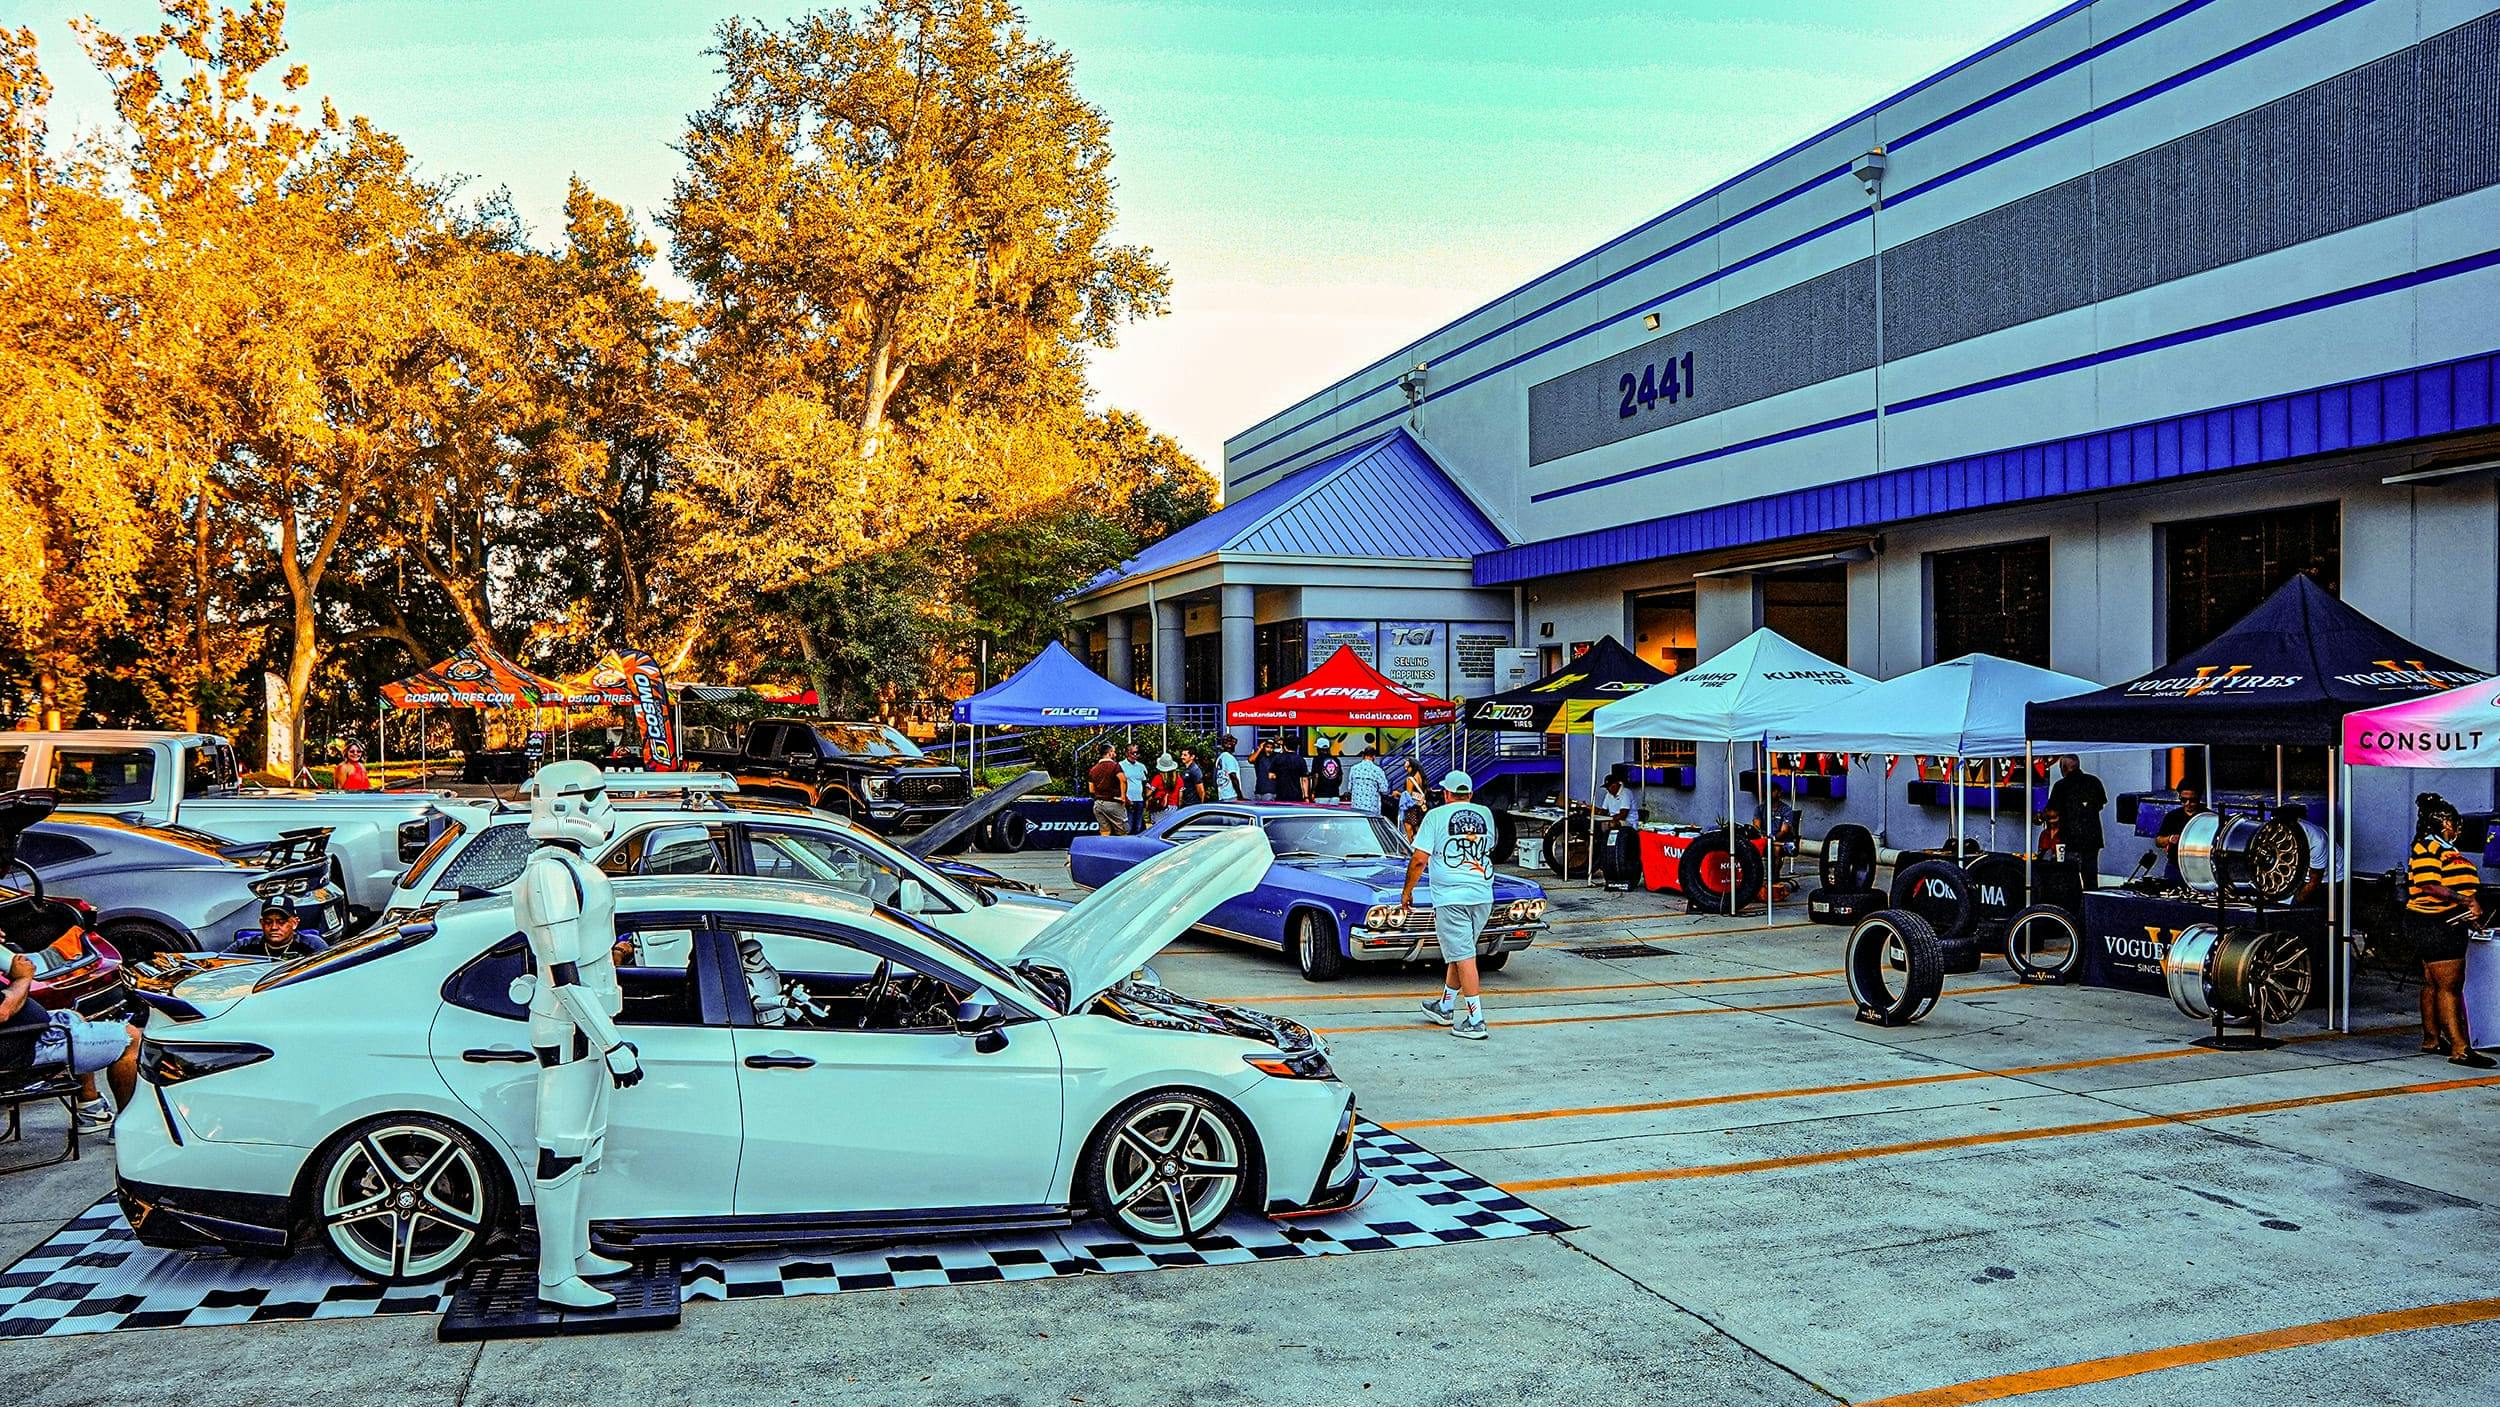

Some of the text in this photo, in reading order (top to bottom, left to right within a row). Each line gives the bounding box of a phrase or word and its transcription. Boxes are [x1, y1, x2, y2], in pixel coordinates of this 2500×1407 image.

[1619, 351, 1694, 418] 2441
[1391, 628, 1434, 646] TGI
[1394, 657, 1428, 667] SELLING
[1389, 670, 1435, 680] HAPPINESS
[1680, 672, 1738, 683] KUMHO
[1763, 671, 1847, 680] KUMHO
[404, 693, 515, 703] COSMO TIRES.COM
[1311, 687, 1380, 698] KENDA
[633, 673, 661, 739] COSMO
[1041, 707, 1099, 716] FALKEN
[1349, 711, 1413, 721] kendatire.com
[1513, 720, 1534, 728] TIRES
[2359, 731, 2483, 750] CONSULT
[1038, 821, 1099, 832] DUNLO
[2104, 935, 2165, 960] VOGUE
[2137, 964, 2160, 975] SINCE
